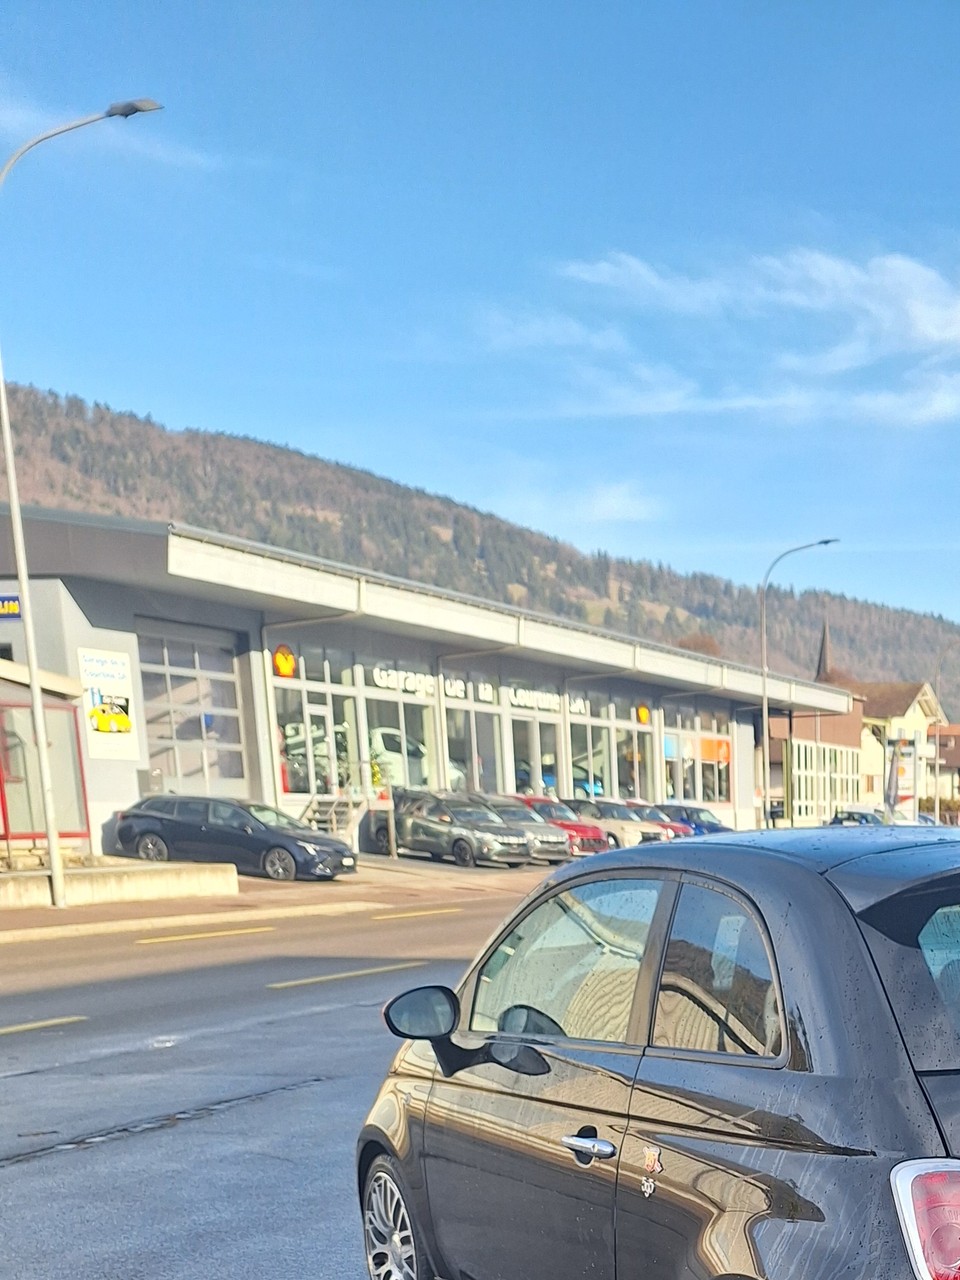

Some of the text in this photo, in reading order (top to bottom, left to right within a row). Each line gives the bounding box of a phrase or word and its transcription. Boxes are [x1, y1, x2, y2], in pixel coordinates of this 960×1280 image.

[373, 667, 436, 698] Garage
[444, 677, 466, 699] de
[478, 682, 494, 702] la
